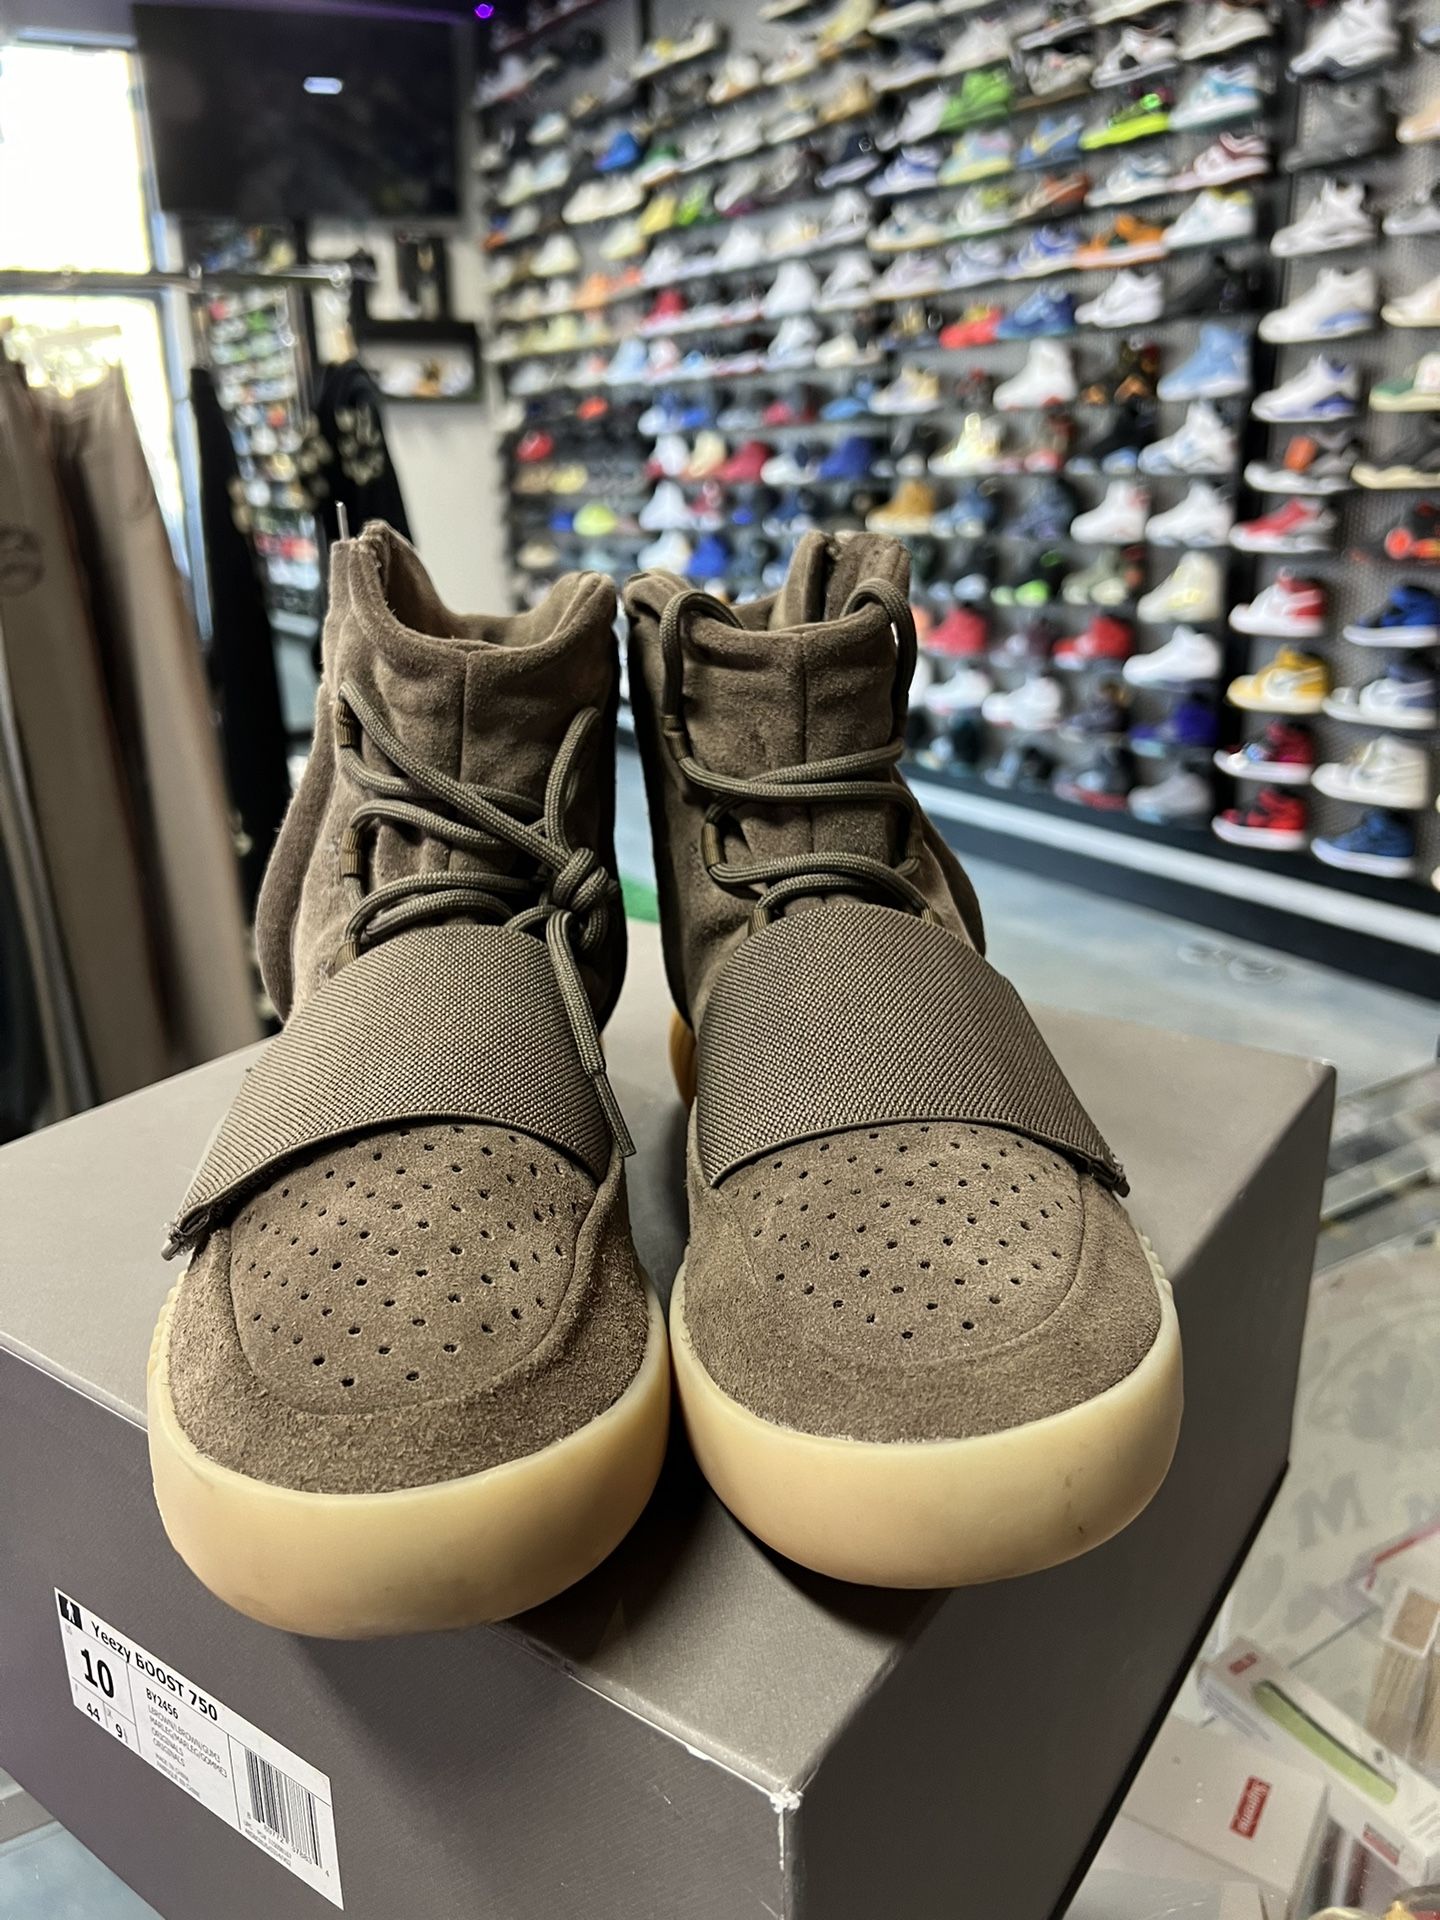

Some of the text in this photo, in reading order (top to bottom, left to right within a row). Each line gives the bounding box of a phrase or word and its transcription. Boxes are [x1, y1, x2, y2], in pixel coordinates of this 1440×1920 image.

[81, 1649, 114, 1698] 10
[92, 1621, 130, 1663] Yeezy
[189, 1690, 217, 1720] 750
[87, 1703, 100, 1721] 44
[146, 1688, 178, 1719] BY2456
